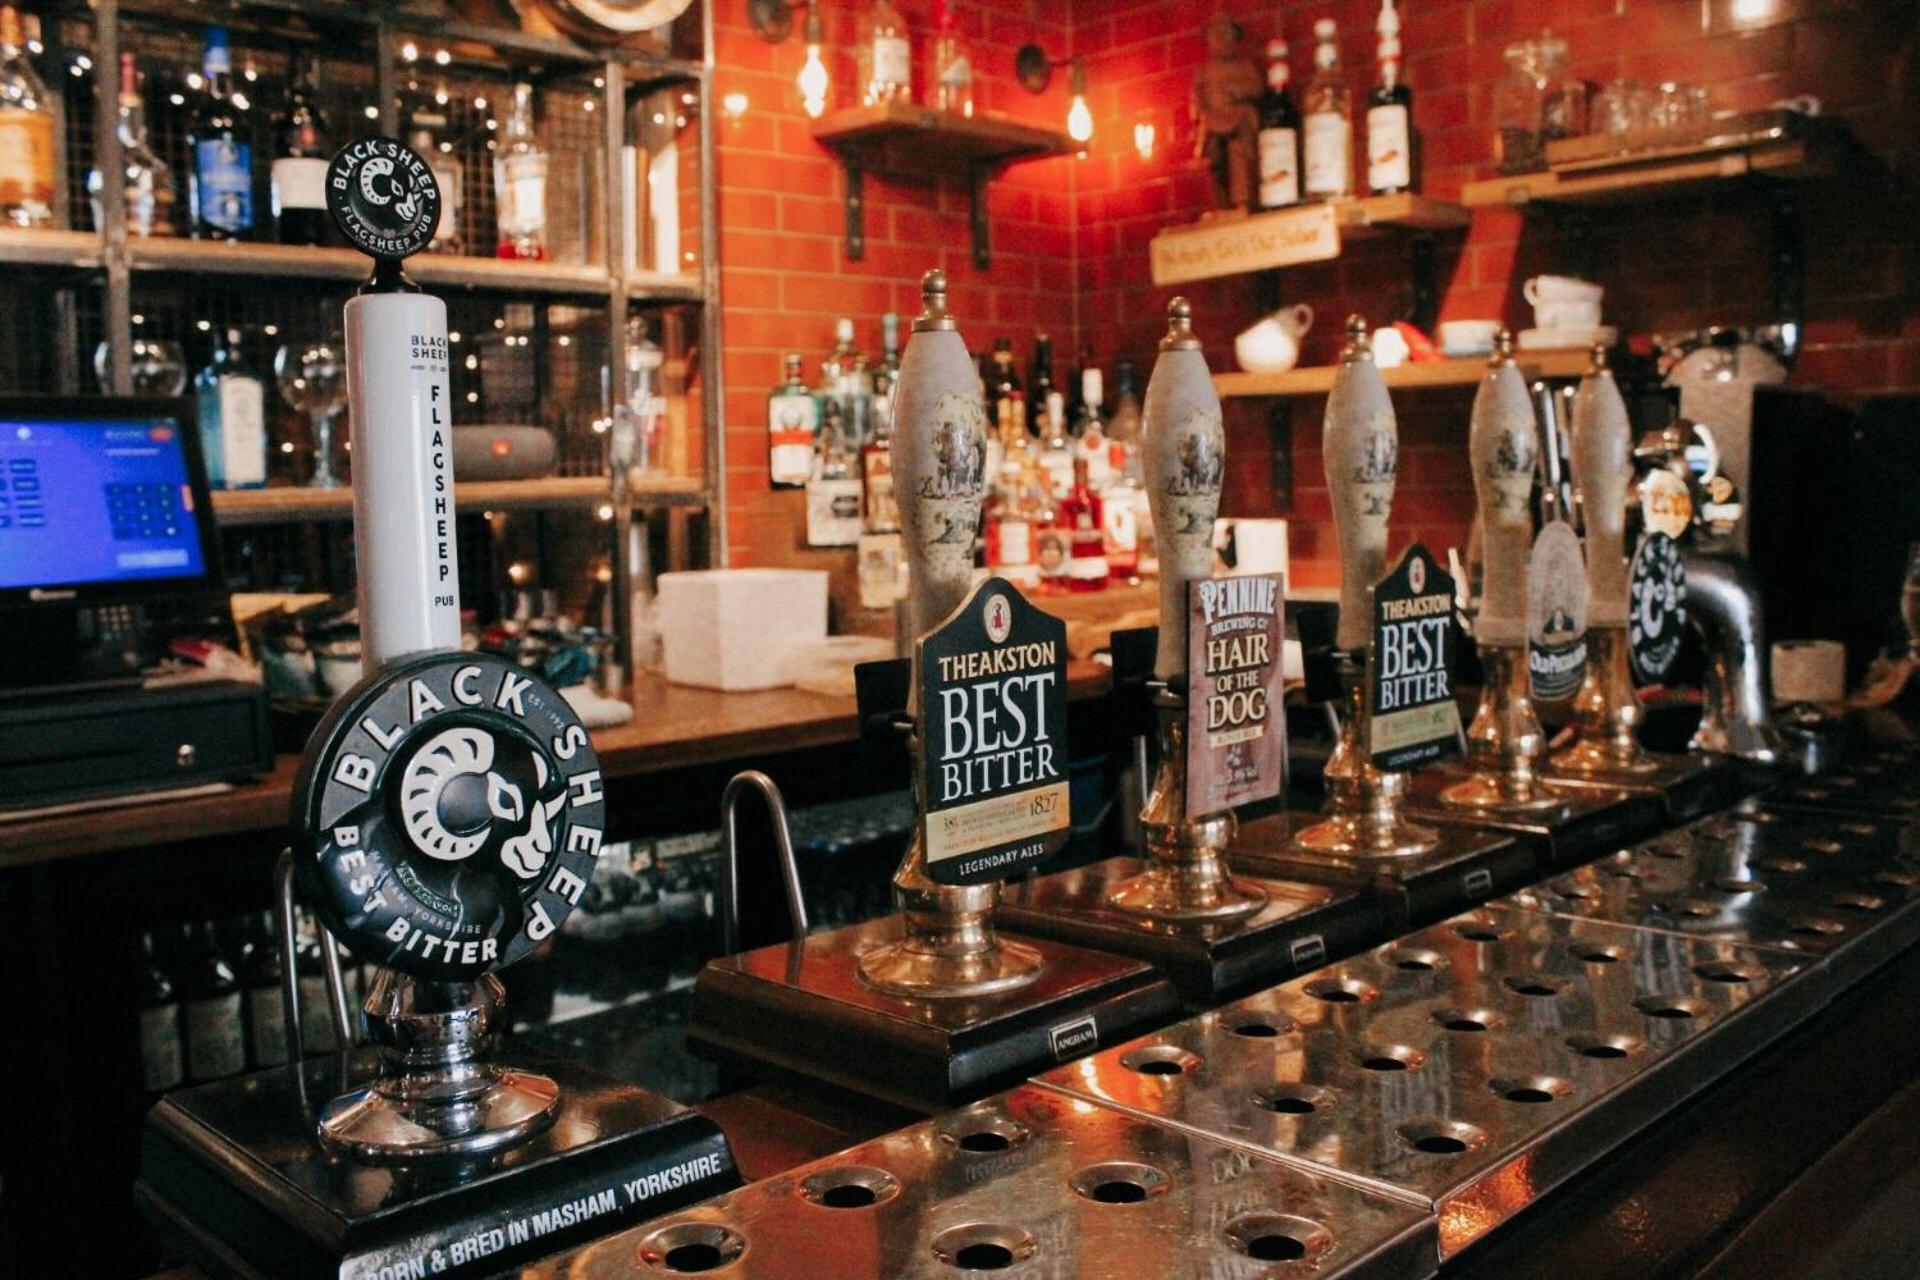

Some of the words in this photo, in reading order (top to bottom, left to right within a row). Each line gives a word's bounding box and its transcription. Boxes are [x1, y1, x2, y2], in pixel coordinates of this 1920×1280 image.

[333, 140, 379, 190] BLACK
[387, 143, 436, 199] SHEEP
[413, 214, 432, 240] PUB
[431, 385, 449, 582] FLAGSHEEP
[434, 595, 455, 607] PUB
[1198, 577, 1277, 625] PENNINE
[1381, 594, 1451, 621] THEAKSTON
[938, 640, 1056, 682] THEAKSTON
[1206, 633, 1270, 673] HAIR
[1381, 616, 1450, 679] BEST
[1216, 675, 1234, 693] OF
[1236, 670, 1260, 689] THE
[1380, 670, 1450, 710] BITTER
[939, 672, 1056, 761] BEST
[1208, 687, 1267, 729] DOG
[940, 743, 1059, 801] BITTER
[334, 666, 533, 793] BLACK
[524, 725, 604, 942] SHEEP
[959, 849, 1018, 876] LEGENDARY
[1020, 843, 1044, 859] ALES
[333, 825, 388, 914] BEST
[386, 916, 499, 966] BITTER
[431, 1249, 447, 1274] &
[450, 1228, 505, 1267] BRED
[508, 1219, 530, 1246] IN
[624, 1152, 722, 1204] YORKSHIRE
